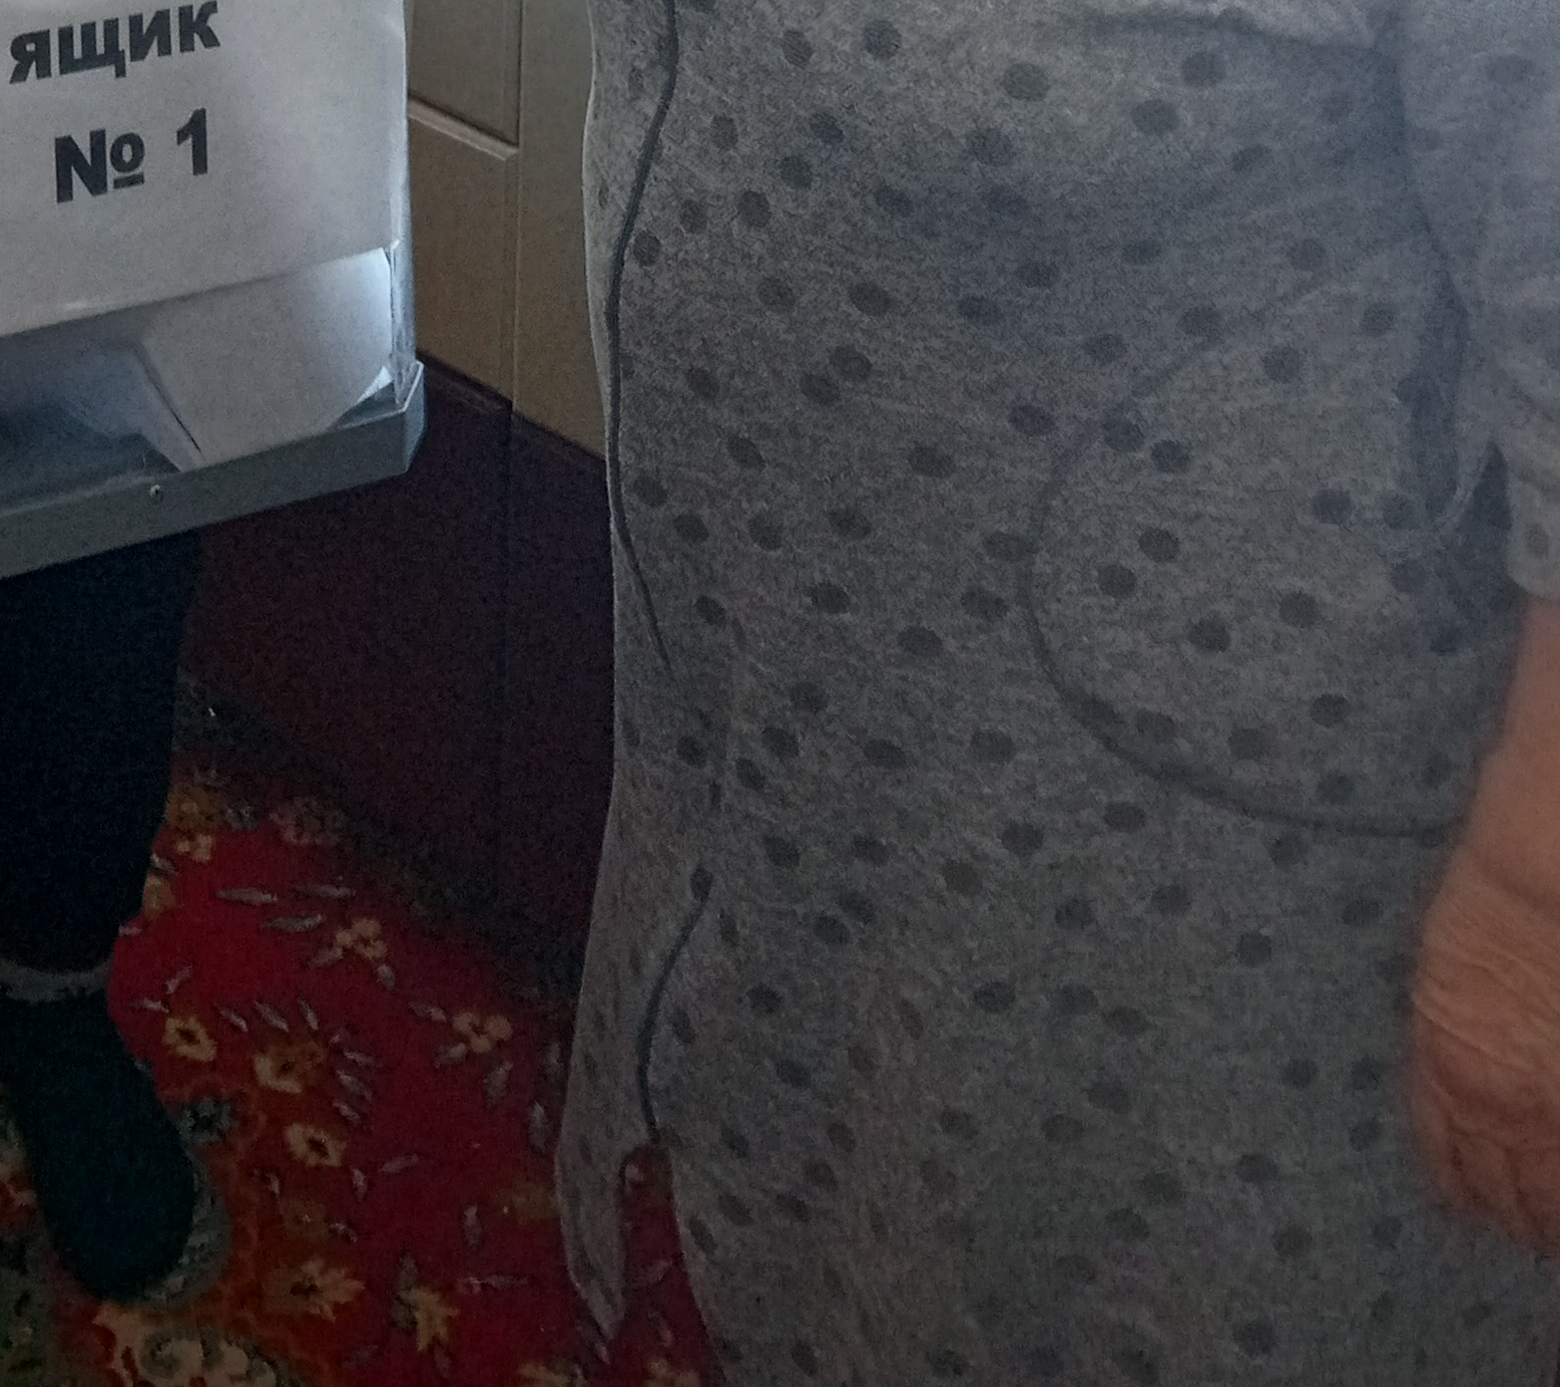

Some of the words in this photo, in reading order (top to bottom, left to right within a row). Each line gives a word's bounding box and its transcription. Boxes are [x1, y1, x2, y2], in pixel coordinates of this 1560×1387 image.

[9, 0, 222, 85] ящик
[54, 128, 146, 205] №
[175, 107, 210, 177] 1
